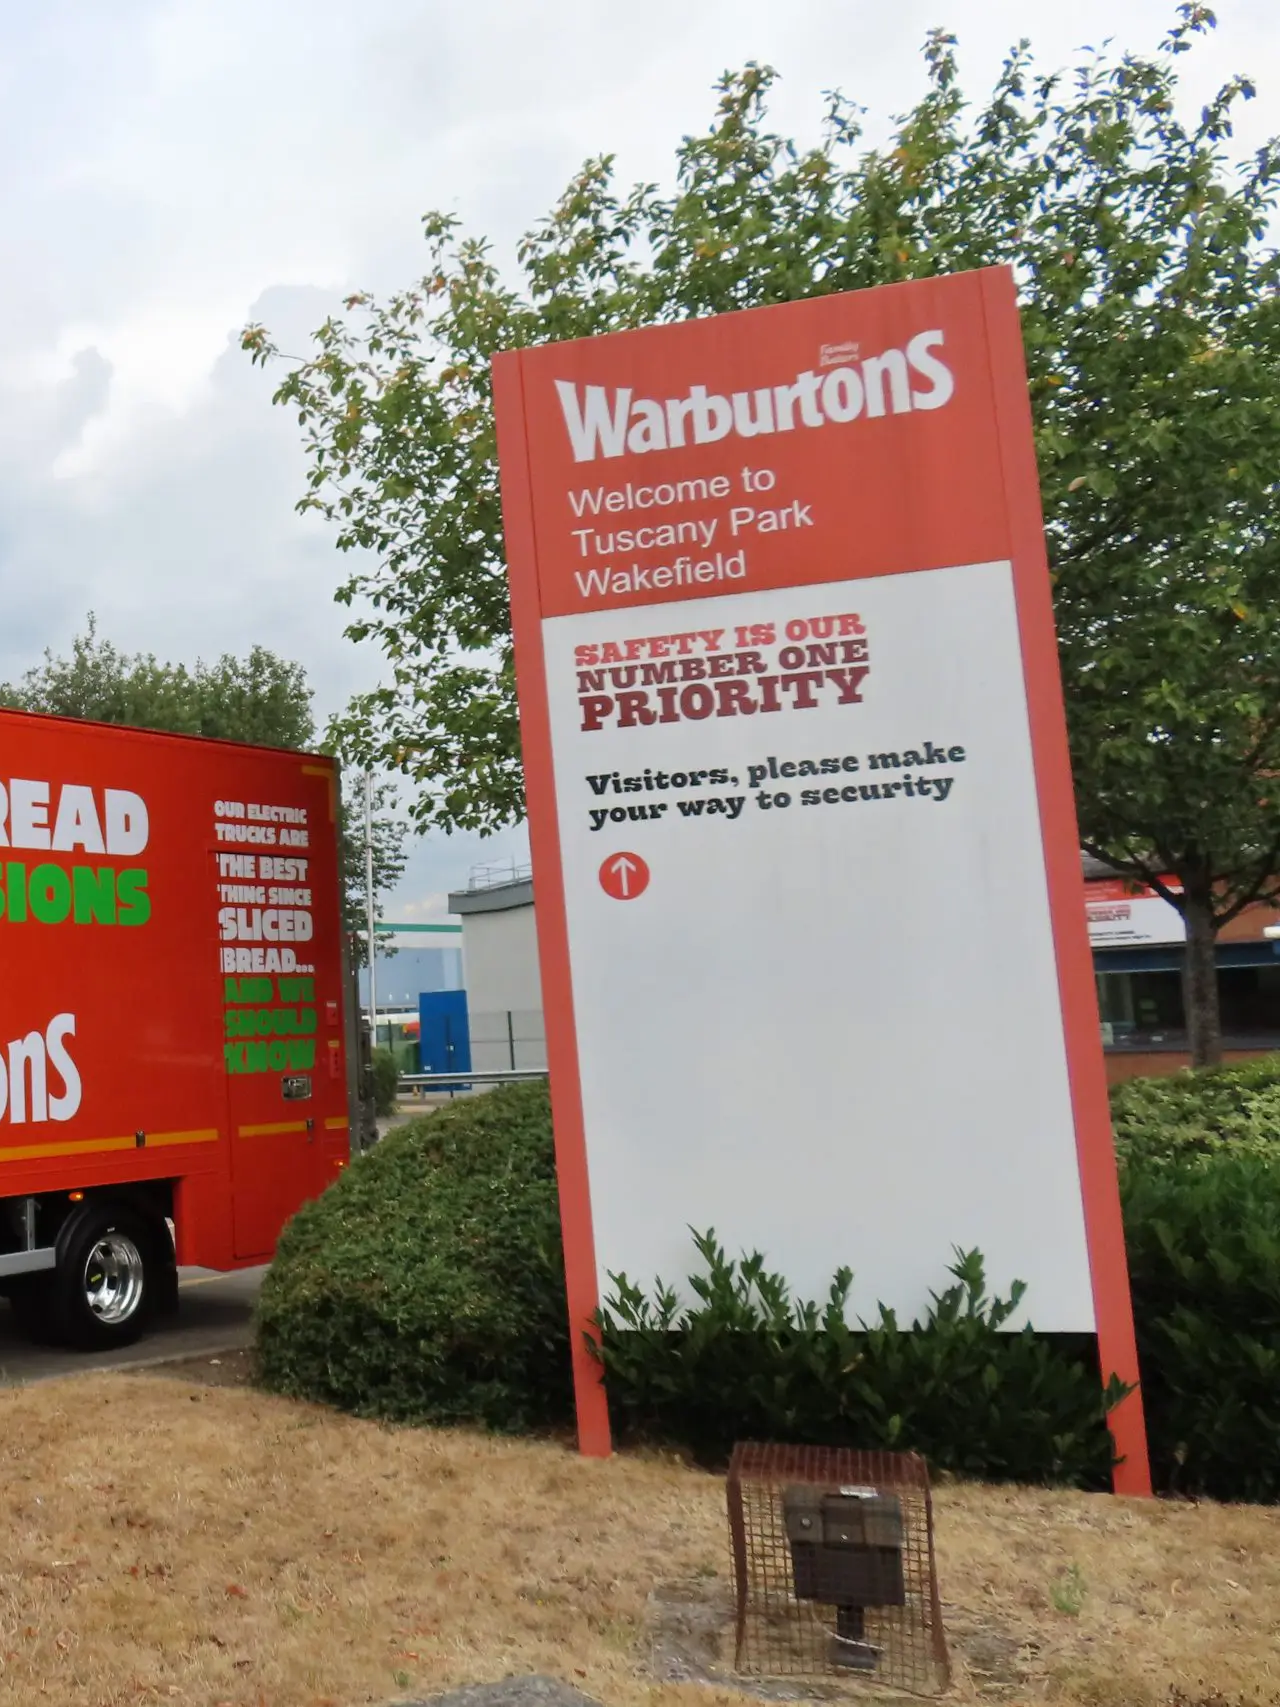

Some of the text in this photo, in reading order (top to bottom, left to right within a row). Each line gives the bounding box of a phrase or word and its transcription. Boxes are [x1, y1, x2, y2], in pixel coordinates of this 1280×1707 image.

[554, 329, 955, 463] Warburtons
[568, 465, 776, 518] Welcome to
[572, 500, 814, 558] Tuscany Park
[574, 549, 747, 598] Wakefield
[573, 612, 866, 668] SAFETY IS OUR
[575, 638, 870, 694] NUMBER ONE
[579, 665, 871, 733] PRIORITY
[585, 741, 967, 797] Visitors, please make
[214, 800, 307, 824] OUR ELECTRIC
[588, 773, 955, 832] your way to security
[215, 822, 309, 847] TRUCKS ARE
[216, 853, 308, 881] THE BEST
[217, 884, 312, 906] THING SINCE
[218, 907, 313, 942] SLICED
[224, 1007, 317, 1037] SHOULD
[224, 1039, 316, 1074] KNOW
